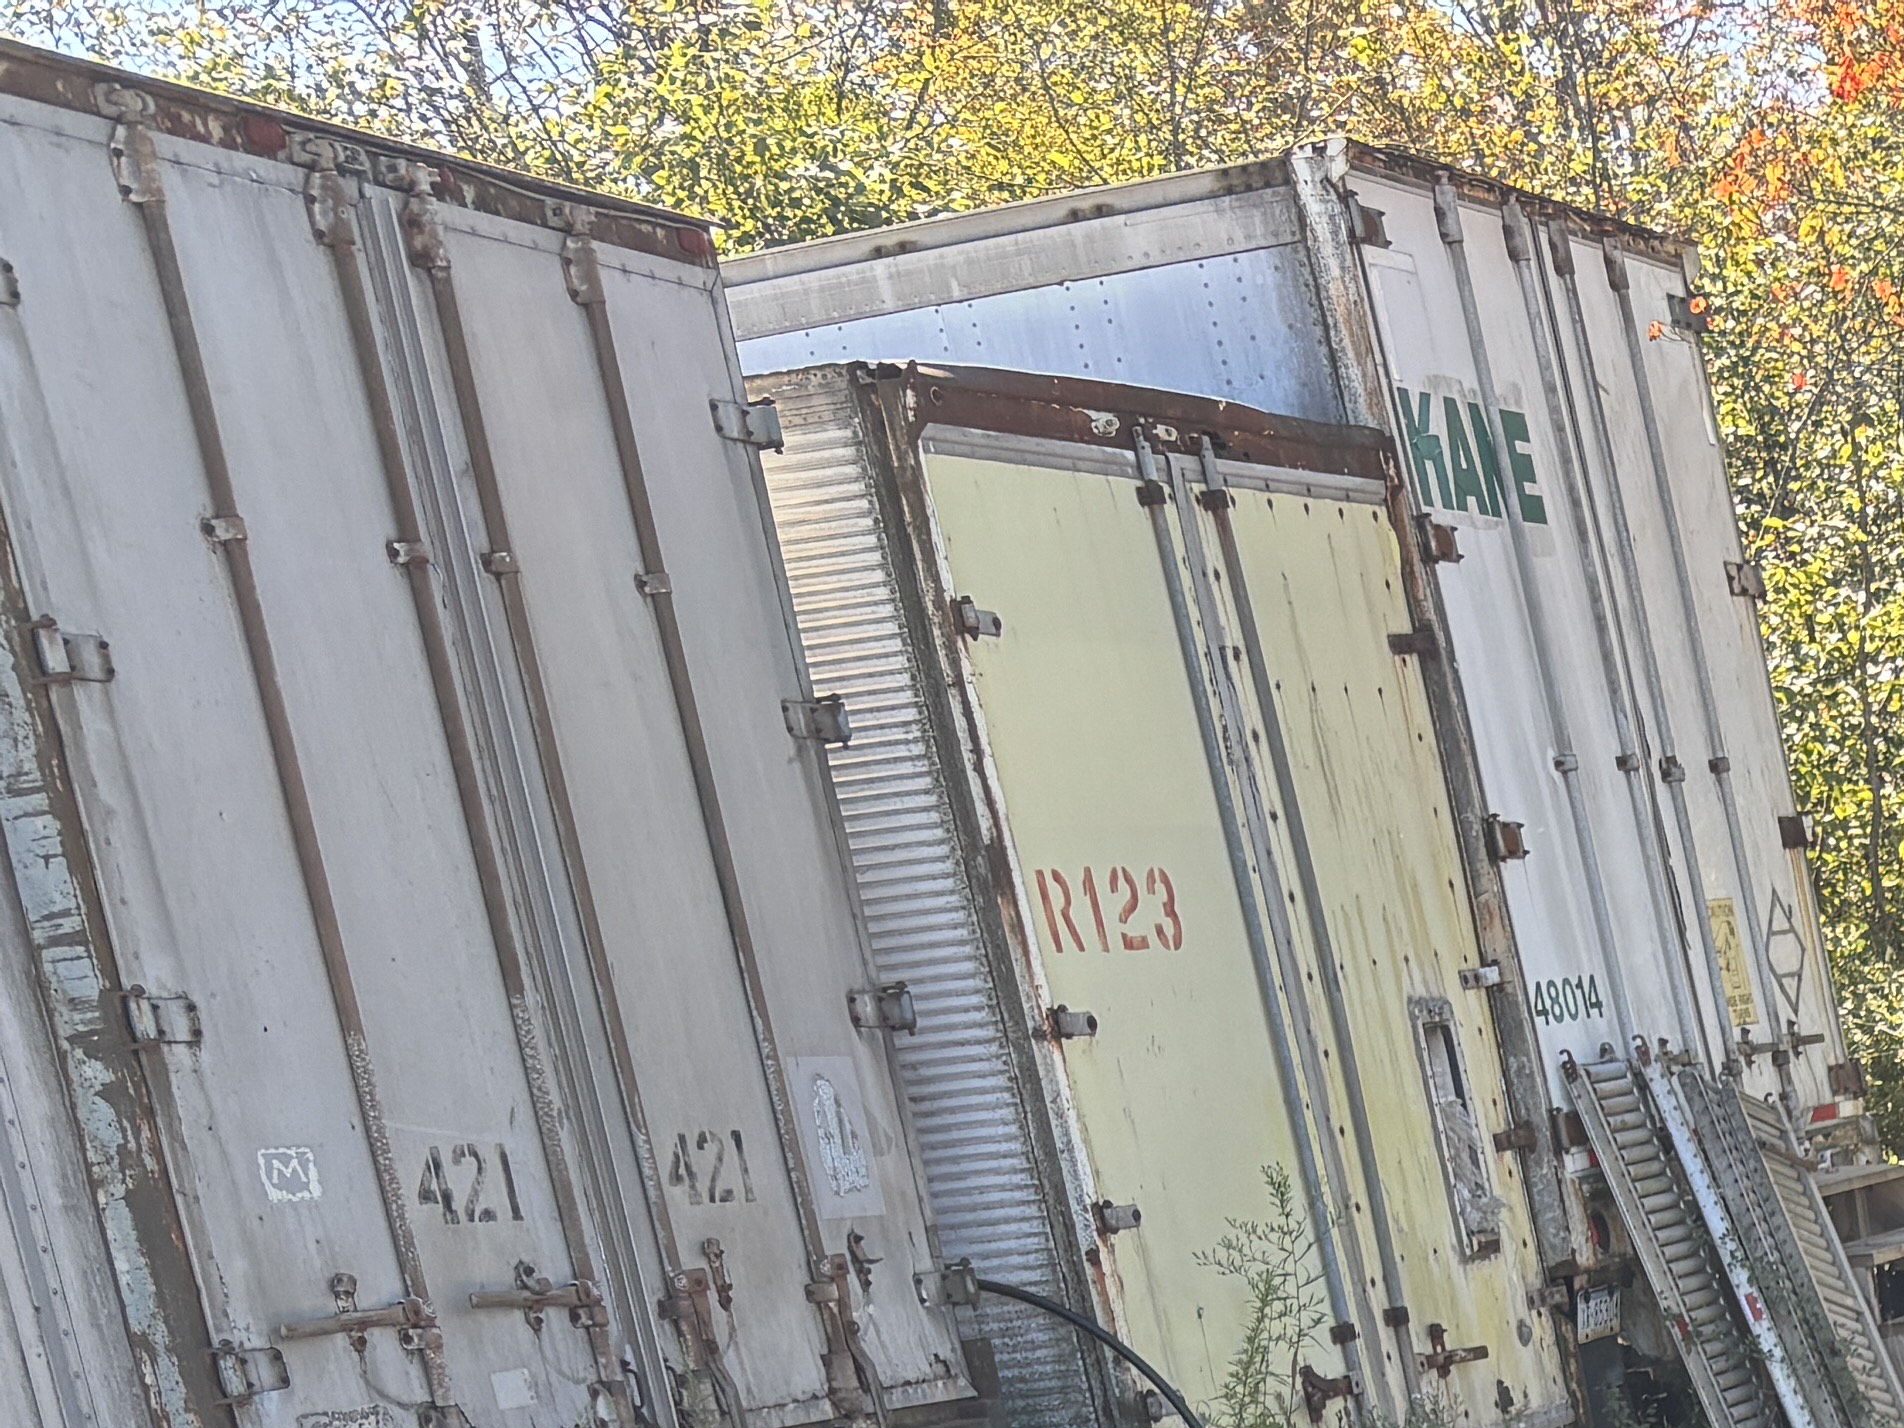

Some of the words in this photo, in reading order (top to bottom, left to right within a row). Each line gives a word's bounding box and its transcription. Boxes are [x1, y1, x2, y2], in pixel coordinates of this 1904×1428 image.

[1397, 386, 1548, 525] KANE
[1035, 866, 1183, 953] R123
[1534, 973, 1603, 1026] 48014
[418, 1143, 524, 1225] 421
[669, 1129, 757, 1205] 421
